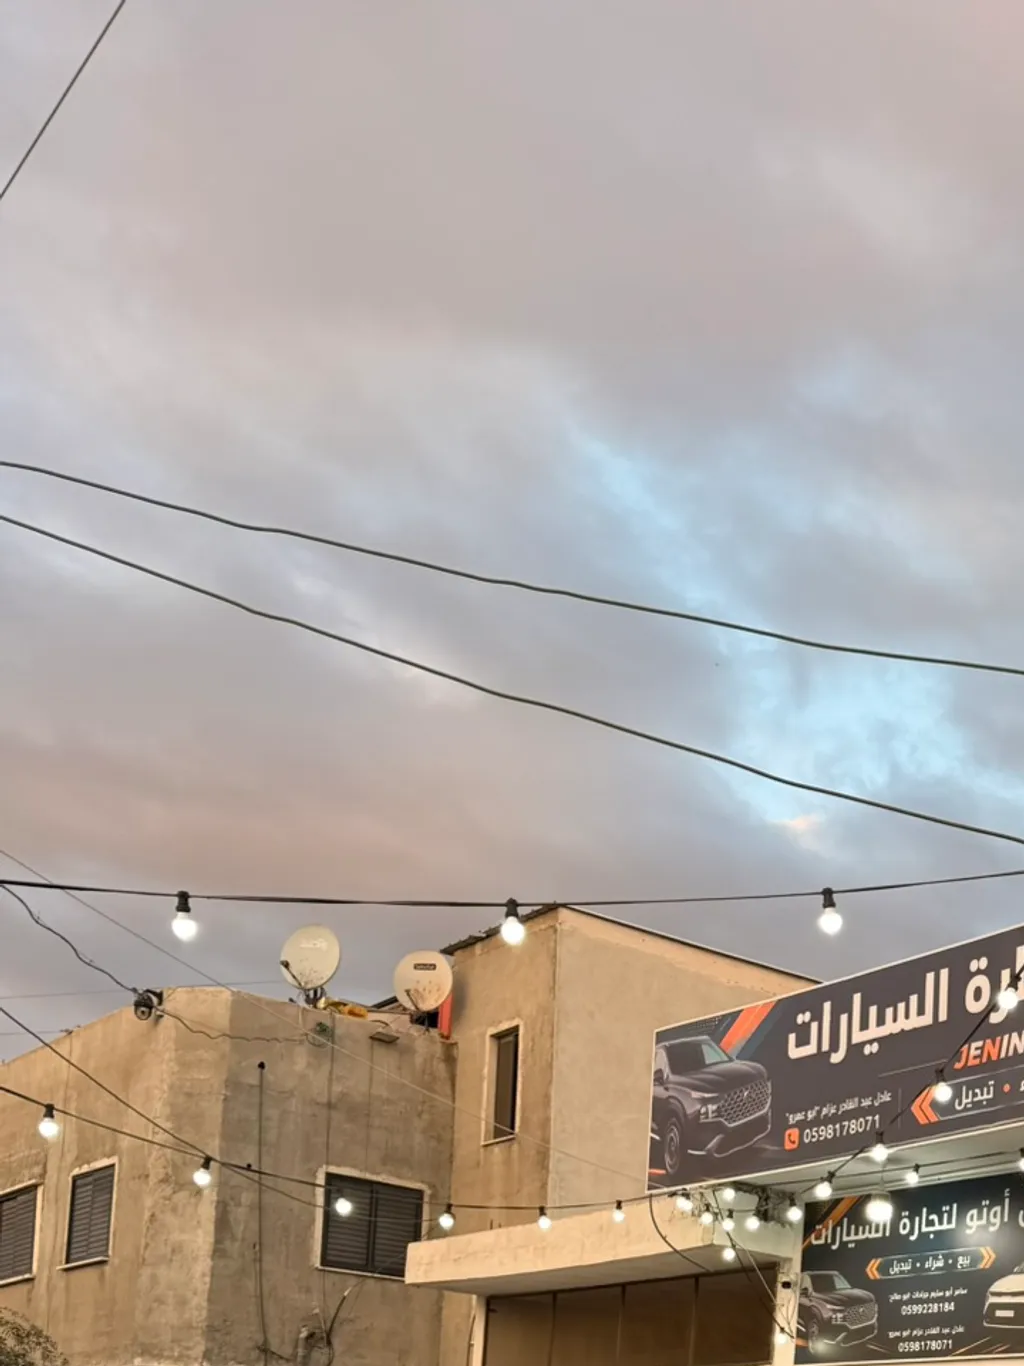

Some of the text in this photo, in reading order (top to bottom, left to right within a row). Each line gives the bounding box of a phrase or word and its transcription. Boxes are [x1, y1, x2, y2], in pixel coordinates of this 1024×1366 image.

[787, 967, 949, 1064] السيارات
[954, 1079, 995, 1110] تبديل
[803, 1114, 880, 1144] 0598178071
[899, 1203, 958, 1241] لتجارة
[965, 1188, 1010, 1235] أوتو
[810, 1215, 891, 1250] السيارات
[888, 1253, 971, 1275] بيع شراء تبديل
[900, 1301, 955, 1316] 0599228184
[897, 1339, 953, 1353] 0598178071
